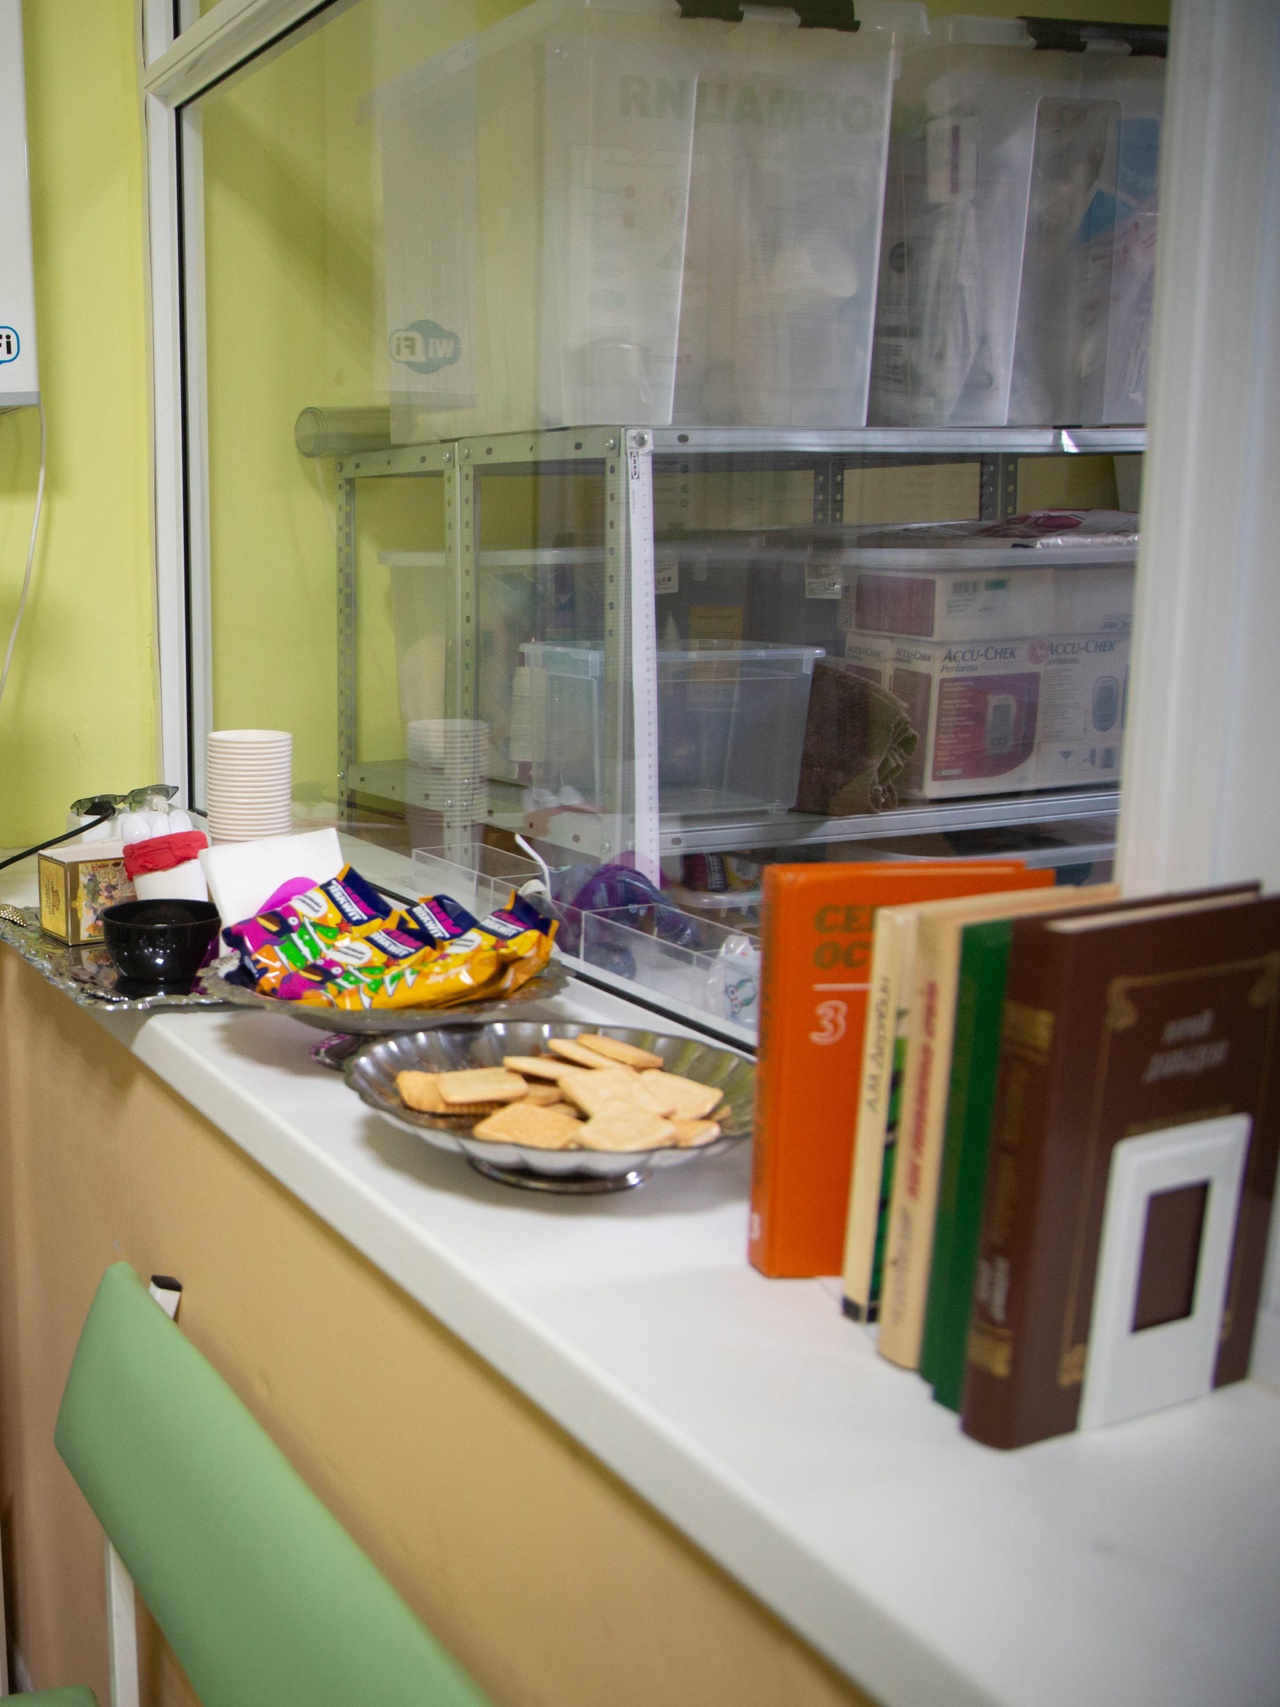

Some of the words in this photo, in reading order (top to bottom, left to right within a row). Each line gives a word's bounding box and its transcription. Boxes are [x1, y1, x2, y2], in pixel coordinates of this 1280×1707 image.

[942, 646, 1018, 663] ACCU-CHEK
[941, 664, 979, 673] Performa
[412, 905, 444, 939] BISKWIT
[809, 1000, 848, 1046] 3
